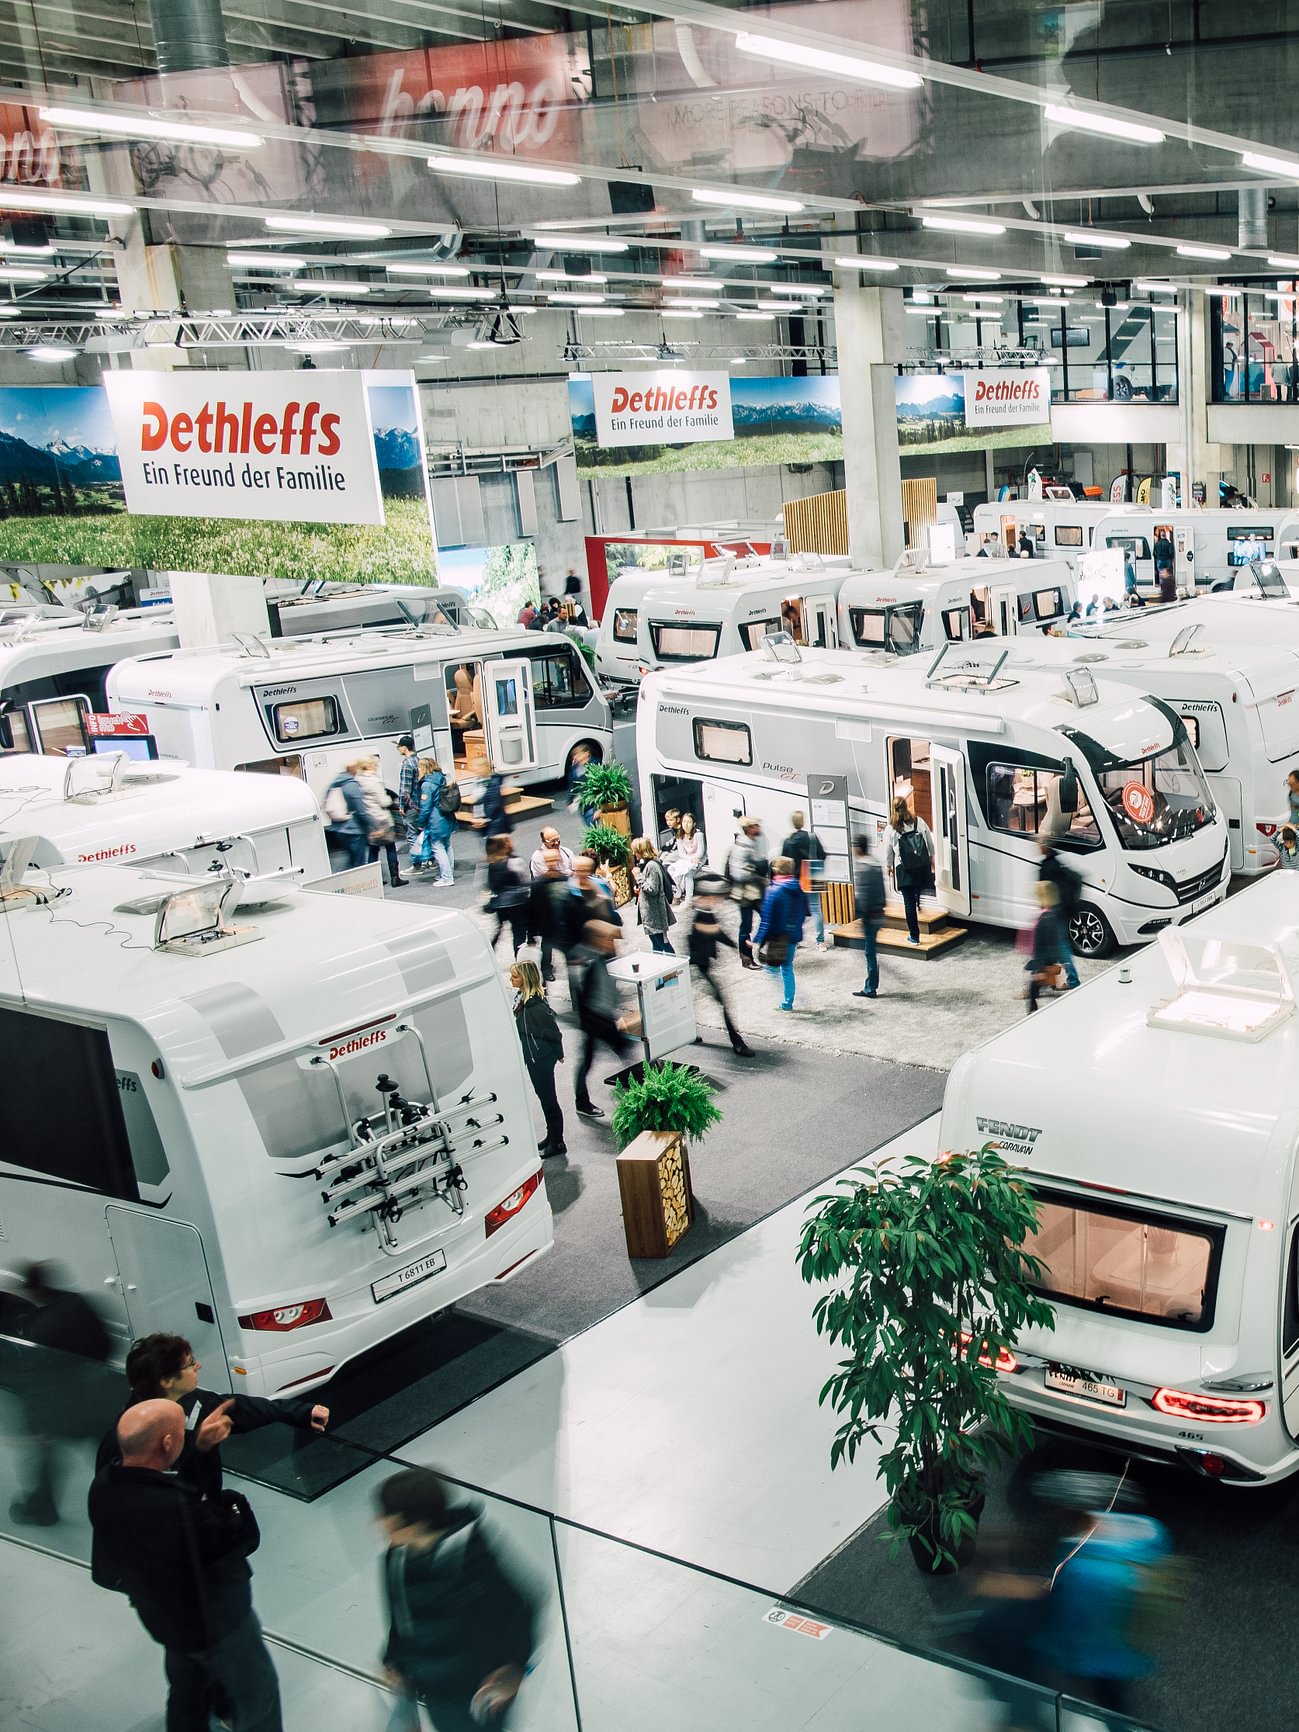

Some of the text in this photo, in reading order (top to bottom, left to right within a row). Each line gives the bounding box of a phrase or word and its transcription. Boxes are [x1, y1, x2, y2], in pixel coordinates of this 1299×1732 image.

[611, 385, 718, 413] Dethleffs
[975, 380, 1040, 401] Dethleffs
[975, 401, 1040, 414] Ein Freund der Familie
[140, 401, 342, 456] Dethleffs
[611, 413, 719, 431] Ein Freund der Familie
[143, 462, 346, 491] Ein Freund der Familie
[263, 686, 297, 698] Dethleffs
[659, 704, 690, 720] Dethleffs
[1181, 703, 1218, 712] Dethleffs
[89, 714, 98, 732] INFO
[78, 843, 137, 862] Dethleffs
[329, 1030, 387, 1060] Dethleffs
[976, 1116, 1043, 1143] FENDT
[999, 1140, 1034, 1156] CARAVAN
[398, 1258, 436, 1282] T 6811 EB
[1082, 1382, 1098, 1394] 465
[1101, 1386, 1115, 1398] TG
[1178, 1430, 1204, 1441] 465
